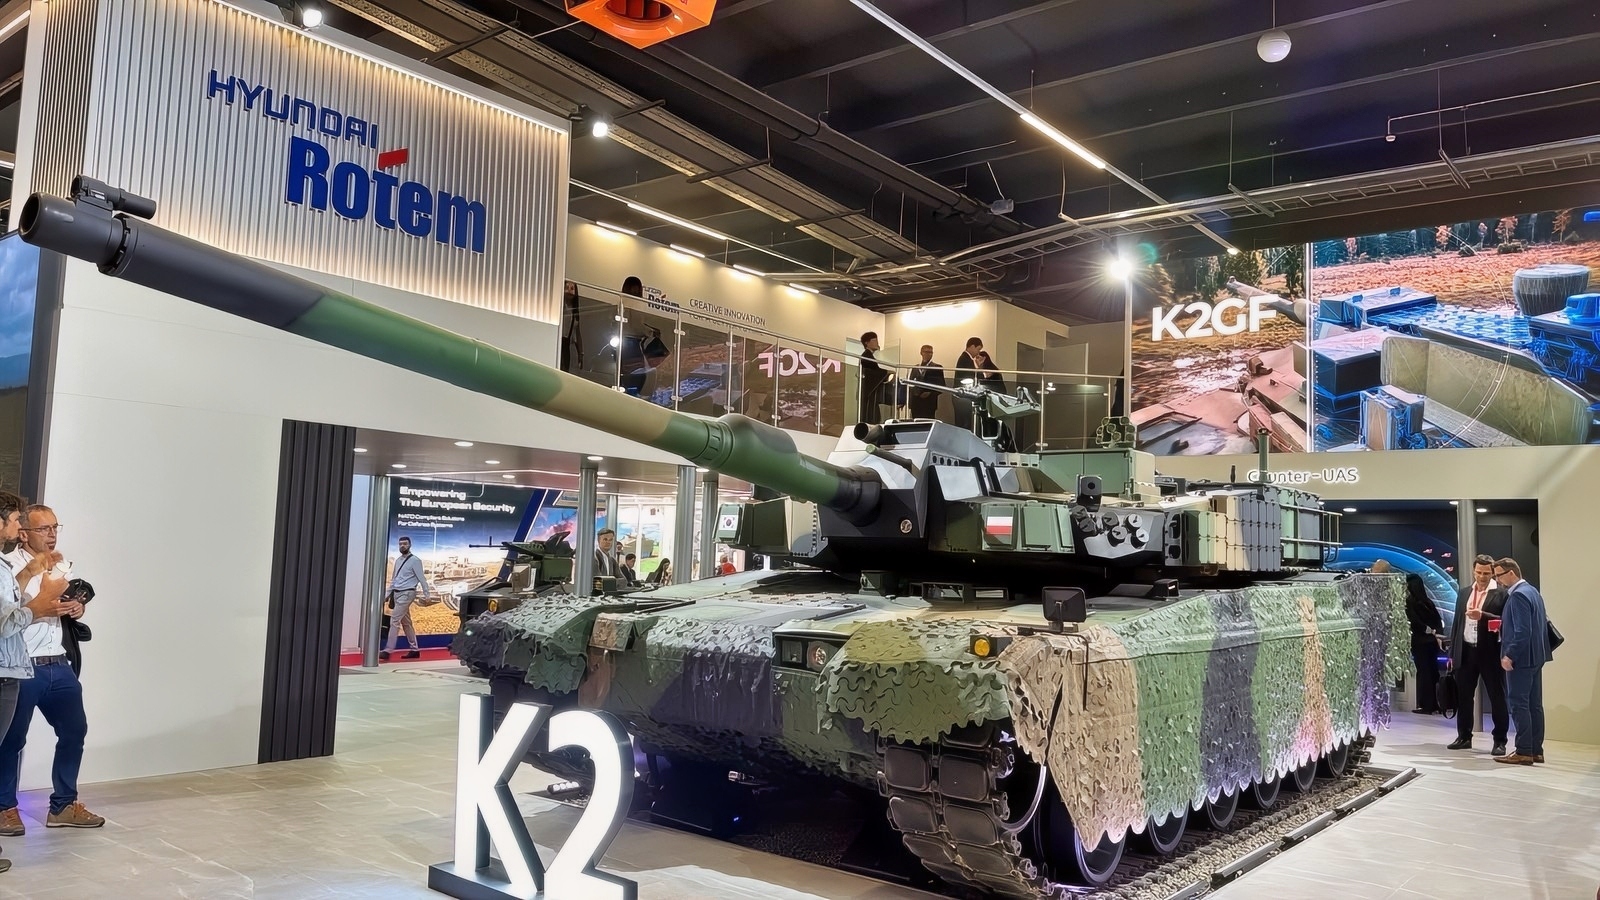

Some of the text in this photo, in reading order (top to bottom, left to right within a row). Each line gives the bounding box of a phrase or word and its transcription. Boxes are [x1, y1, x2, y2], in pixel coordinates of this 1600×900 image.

[207, 69, 378, 149] HYUNDAI
[285, 135, 487, 254] Rotem
[689, 298, 722, 315] CREATIVE
[724, 307, 767, 327] INNOVATION
[1152, 294, 1280, 342] K2GF
[399, 486, 466, 501] Empowering
[1247, 467, 1359, 484] Cunter-UAS
[399, 497, 516, 514] The European Security
[454, 692, 631, 900] K2
